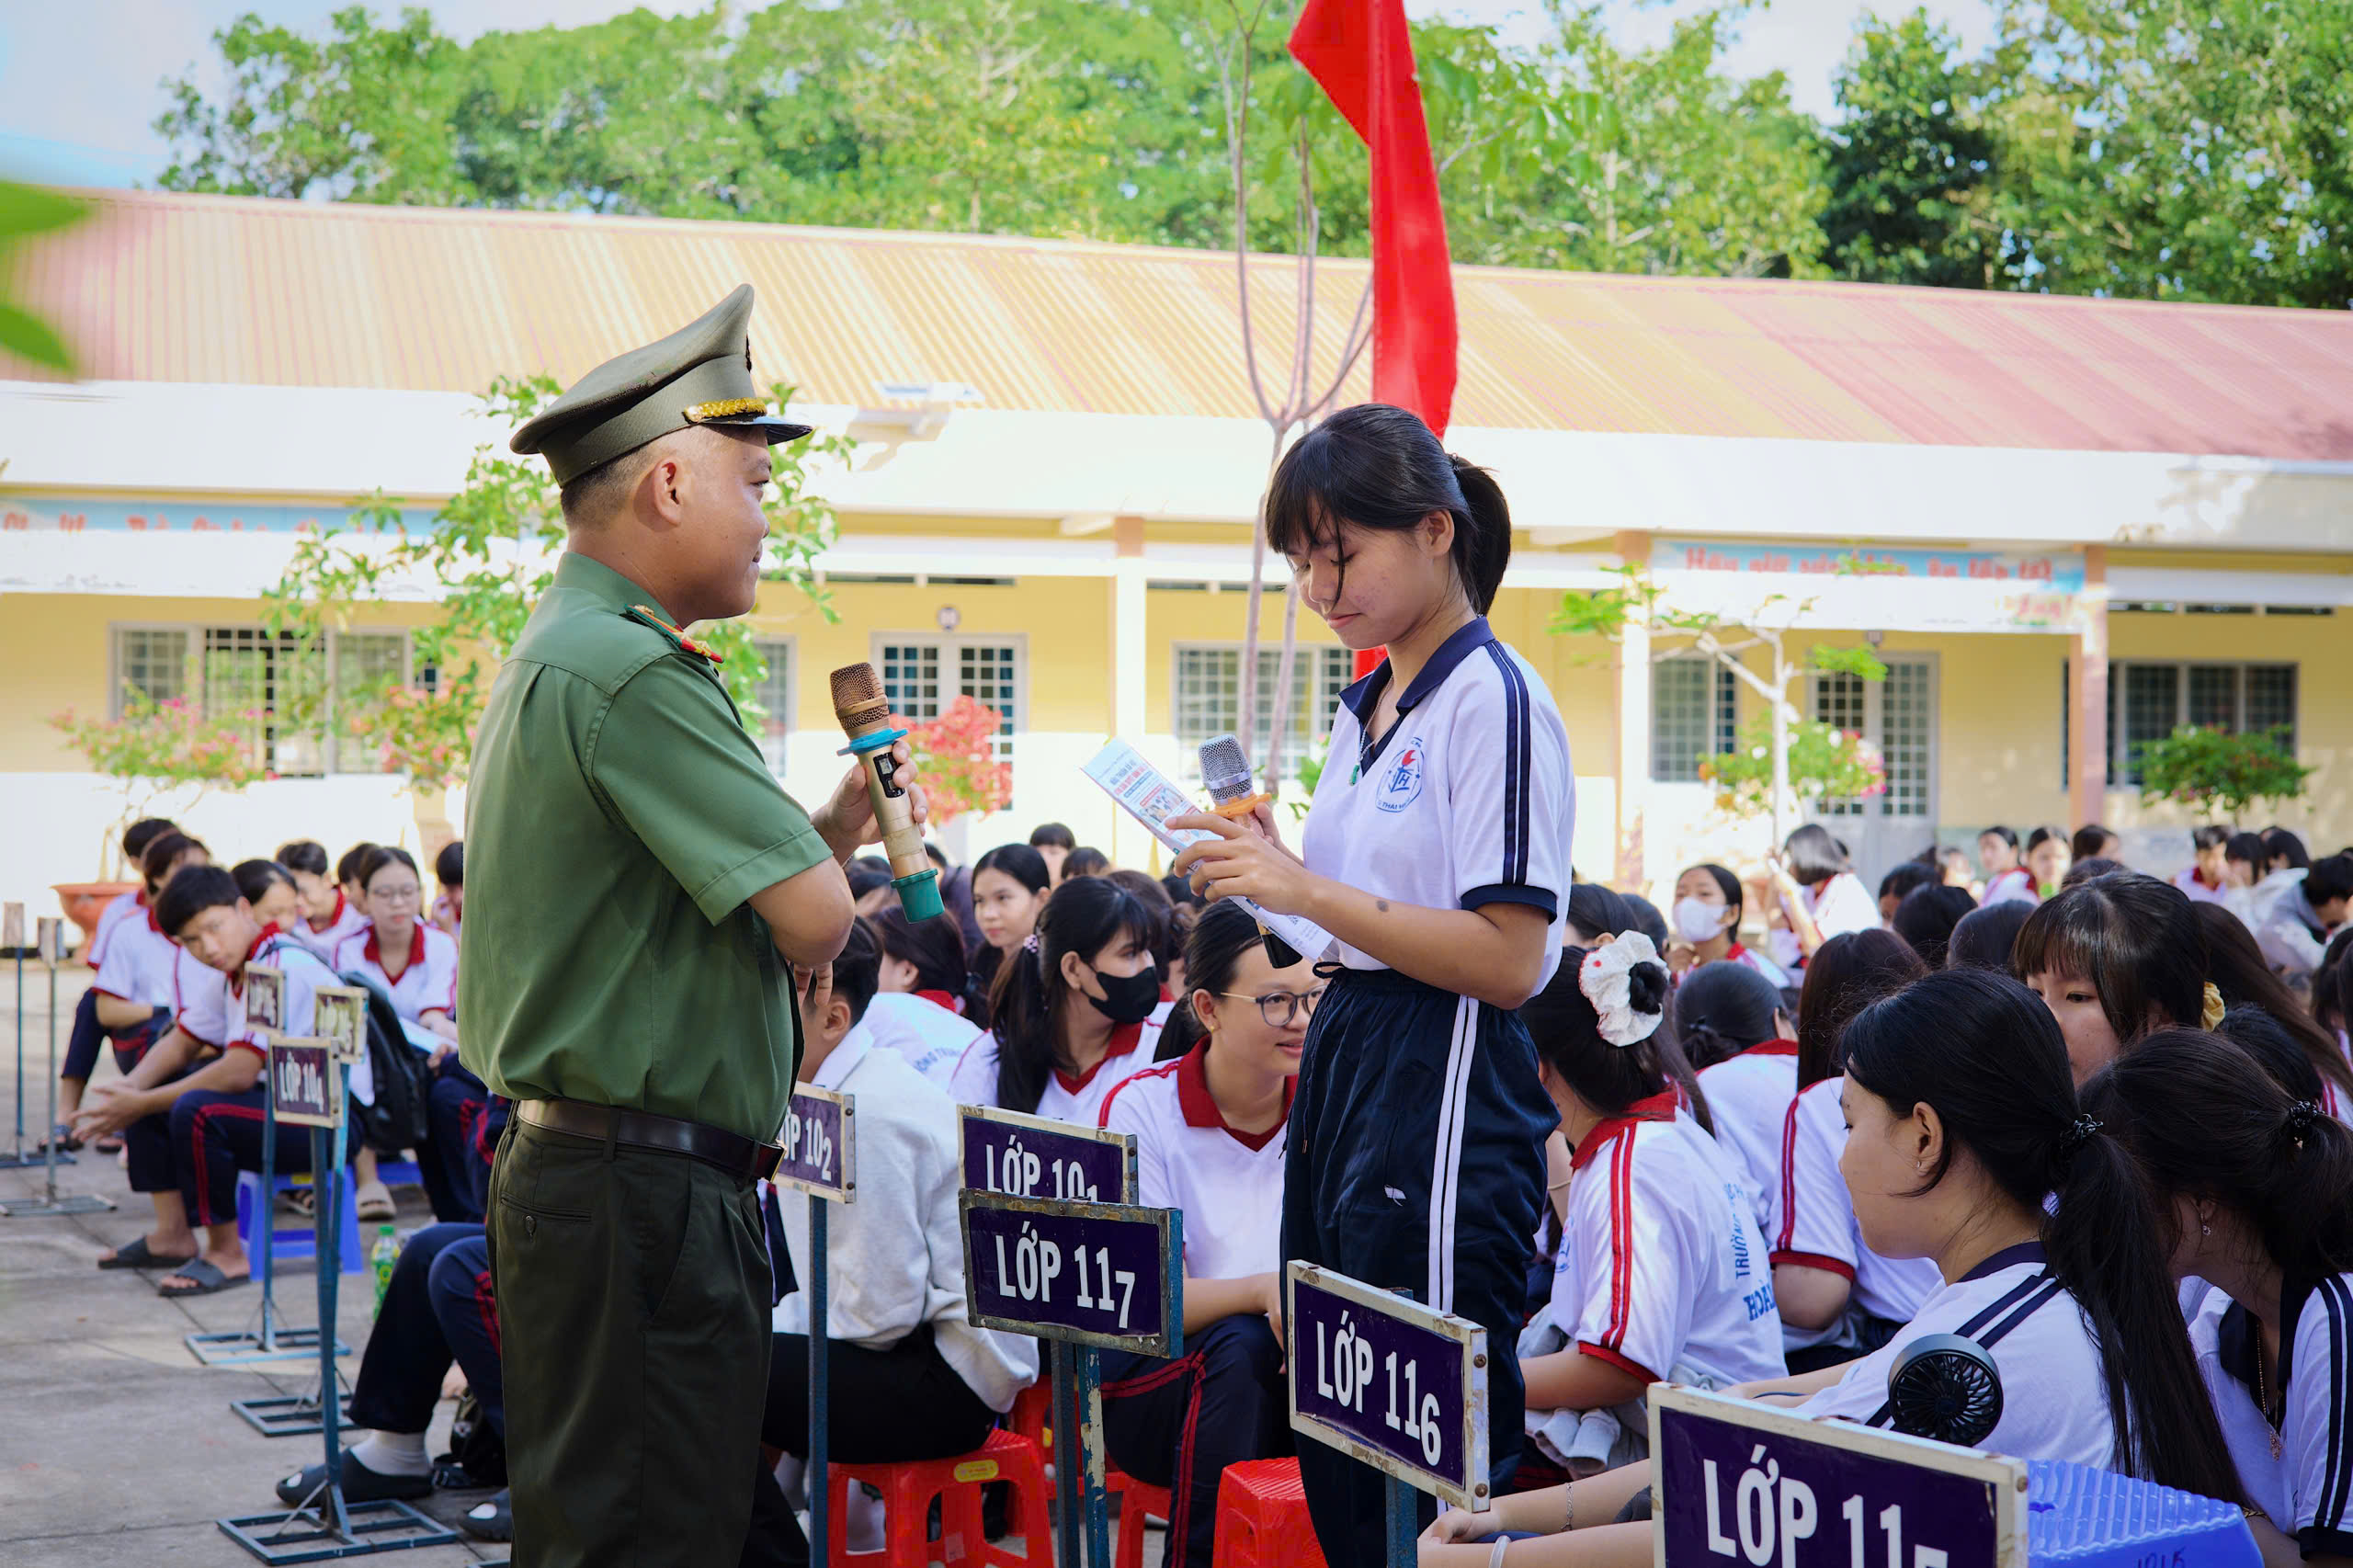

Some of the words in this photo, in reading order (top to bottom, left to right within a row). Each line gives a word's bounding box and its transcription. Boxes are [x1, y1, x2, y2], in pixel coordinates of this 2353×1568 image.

[279, 1051, 301, 1102] LỚP
[805, 1117, 832, 1182] 102
[986, 1134, 1040, 1197] LỚP
[995, 1221, 1062, 1302] LỚP
[1074, 1244, 1136, 1329] 117
[1317, 1310, 1374, 1414] LỚP
[1385, 1351, 1441, 1467] 116
[1703, 1443, 1818, 1568] LỚP
